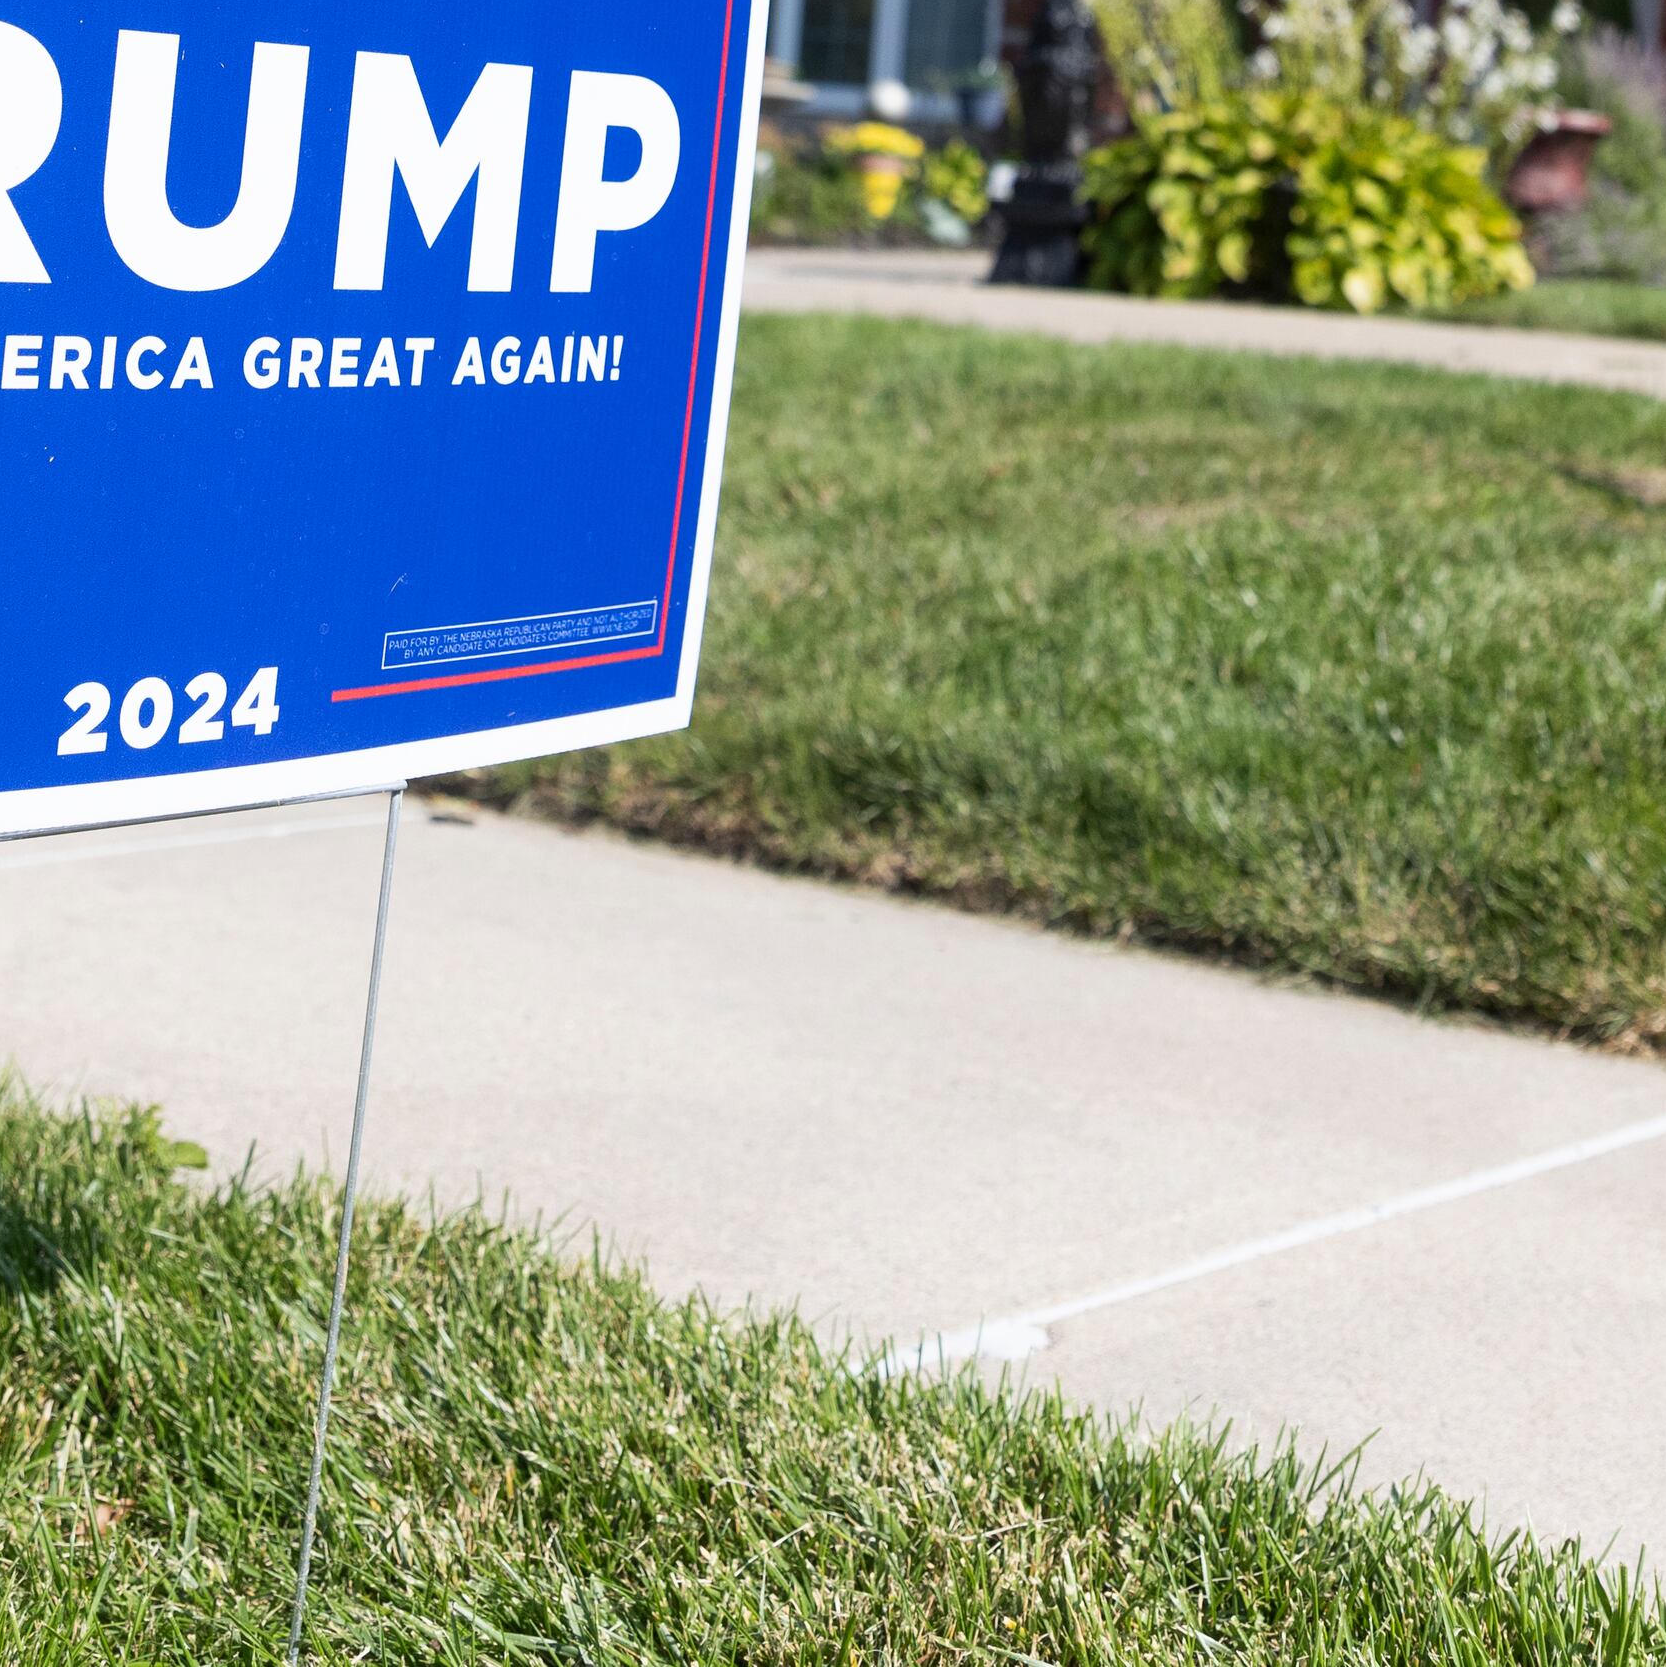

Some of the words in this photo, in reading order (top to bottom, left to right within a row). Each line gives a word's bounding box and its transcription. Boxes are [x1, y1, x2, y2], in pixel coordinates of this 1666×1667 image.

[243, 336, 434, 389] GREAT
[452, 335, 623, 385] AGAIN!
[388, 639, 409, 650] PAID
[410, 636, 428, 647] FOR
[429, 635, 440, 646] BY
[443, 633, 458, 644] THE
[459, 629, 502, 642] NEBRASKA
[503, 622, 551, 636] REPUBLICAN
[552, 619, 576, 630] PARTY
[576, 616, 593, 626] AND
[593, 613, 609, 624] NOT
[404, 648, 416, 659] BY
[417, 646, 436, 657] ANY
[437, 640, 483, 655] CANDIDATE
[484, 639, 497, 650] OR
[497, 633, 546, 648] CANDIDATE'S
[57, 667, 279, 755] 2024
